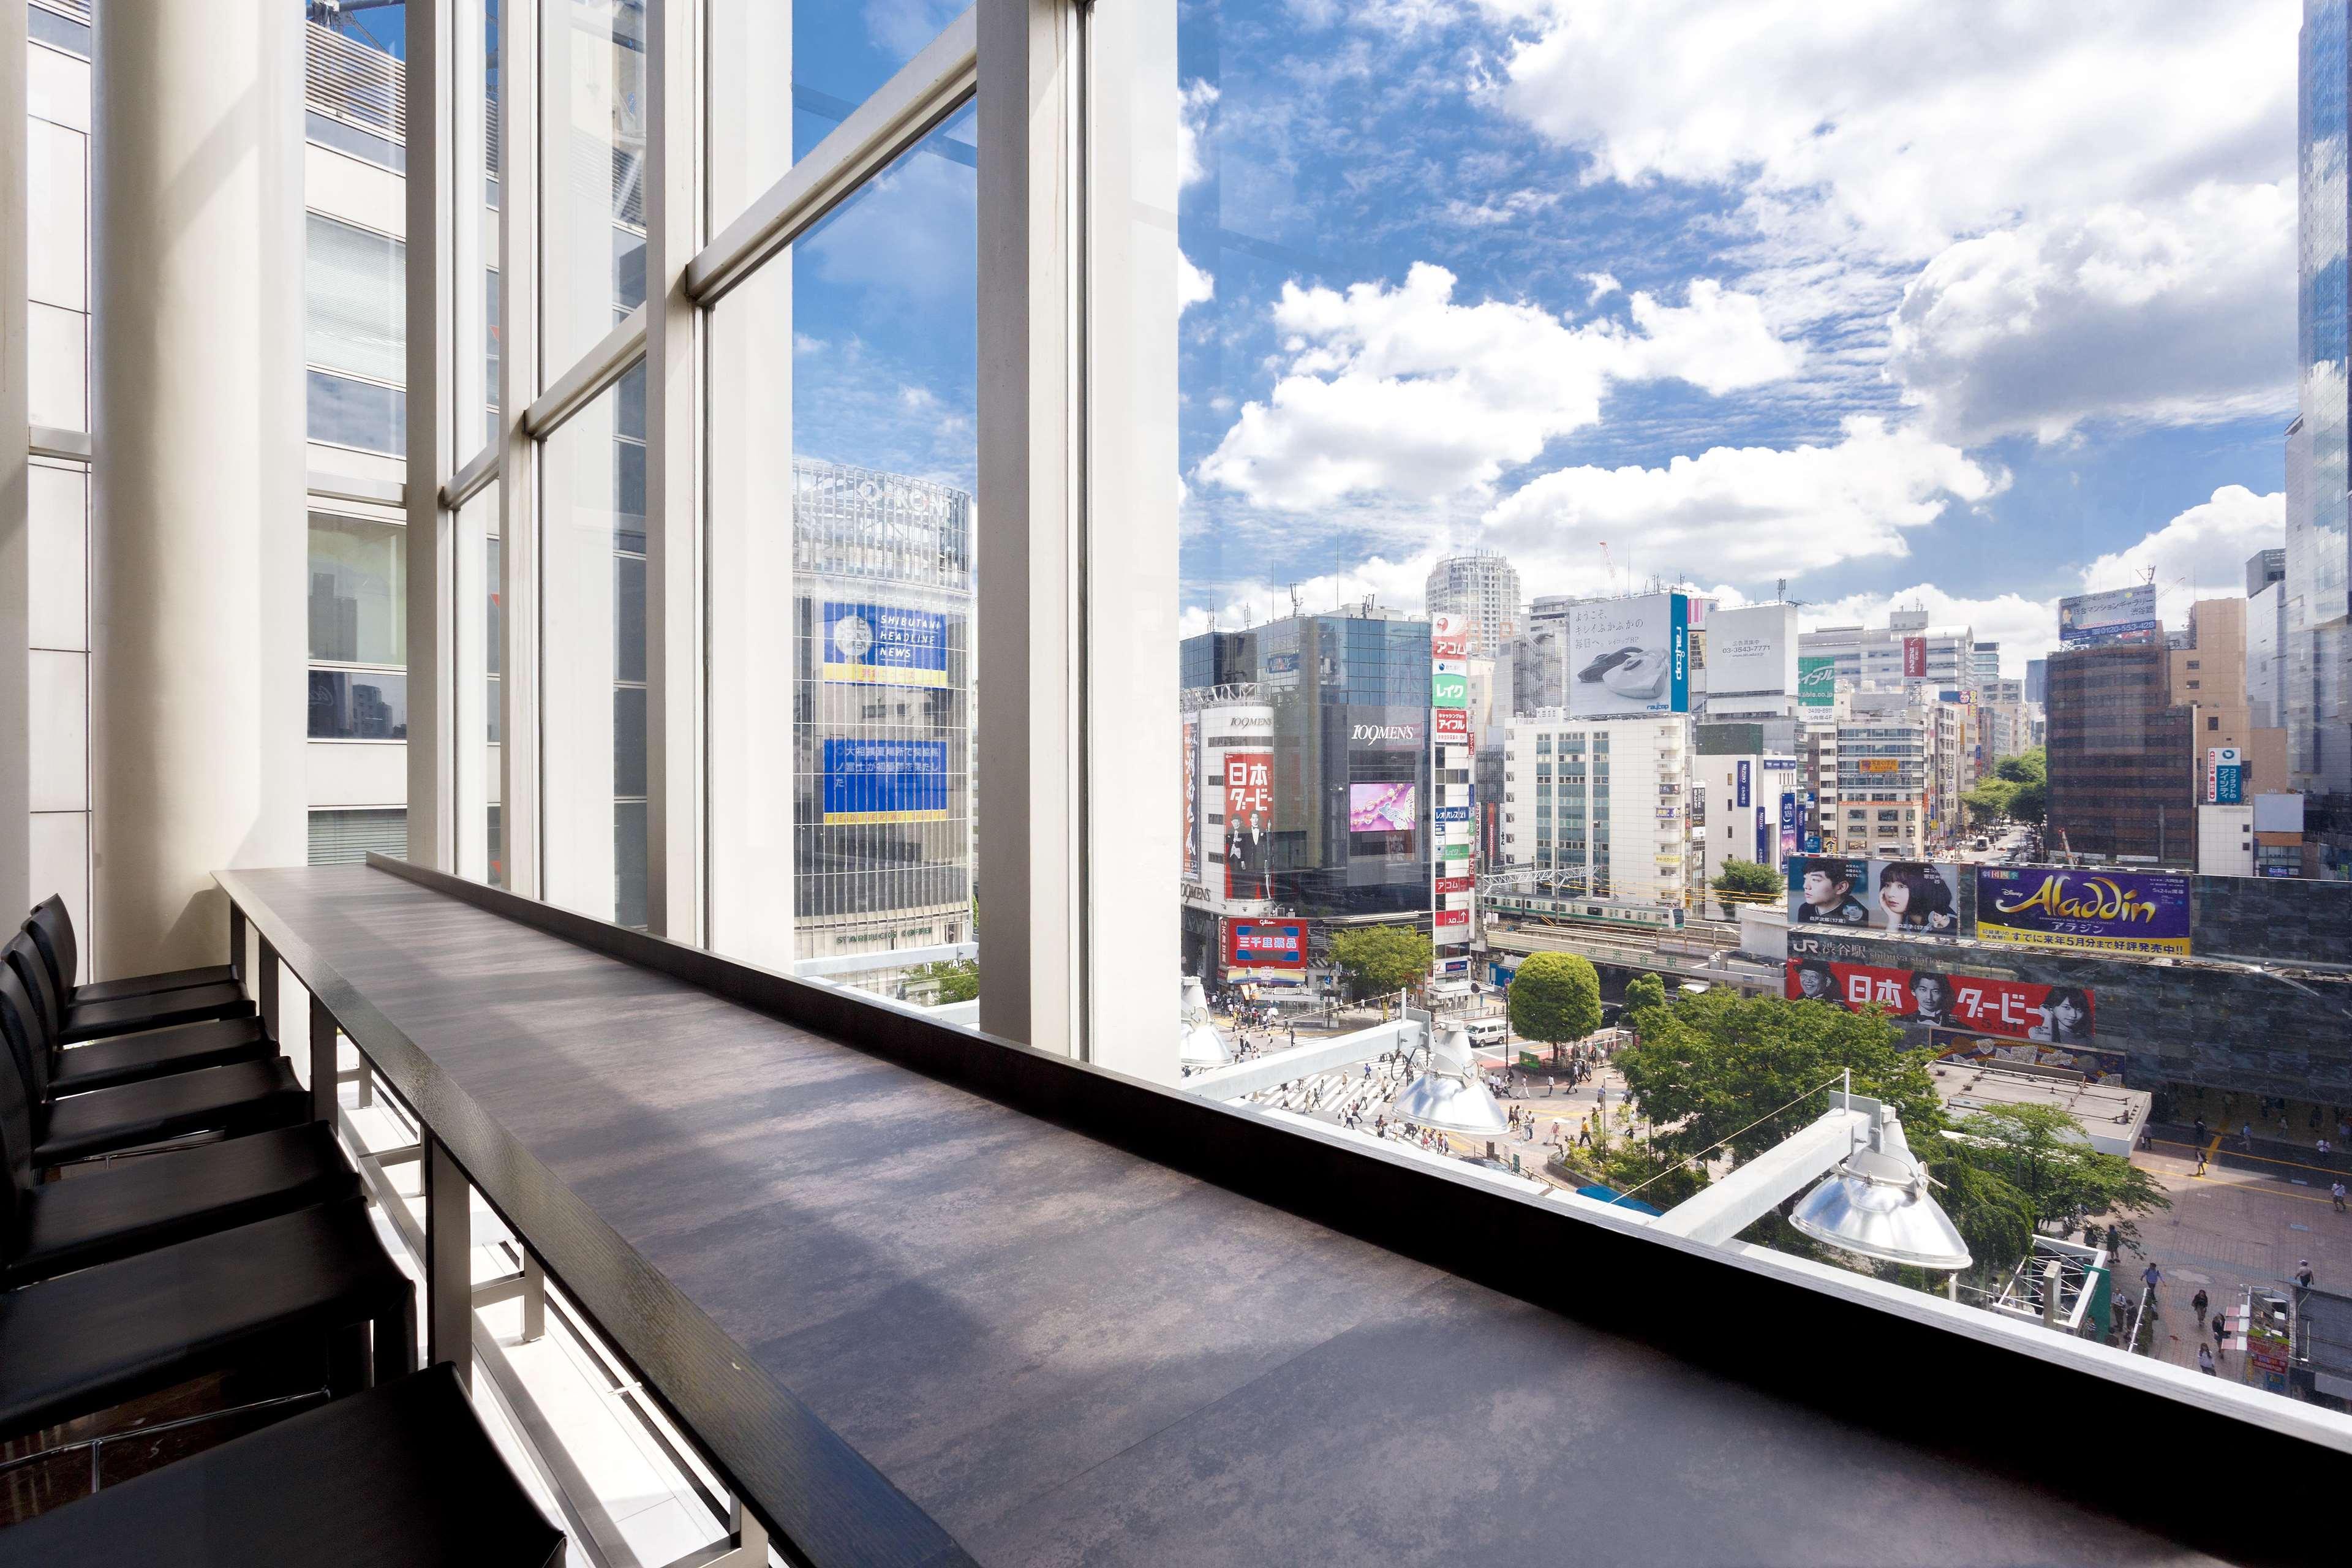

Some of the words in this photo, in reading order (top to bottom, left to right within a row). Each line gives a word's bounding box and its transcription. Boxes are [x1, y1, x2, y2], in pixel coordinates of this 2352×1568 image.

[2101, 622, 2154, 635] 0120-553-428
[880, 631, 935, 644] HEADLINE
[880, 648, 911, 658] NEWS
[1436, 641, 1466, 655] アコム
[1675, 626, 1685, 680] raycop
[1722, 645, 1771, 654] 03-3543-7771
[1436, 684, 1464, 698] レイク
[1646, 702, 1669, 710] raycop
[1438, 719, 1465, 730] アイフル
[1351, 725, 1414, 746] 109MEN'S
[1229, 763, 1268, 786] 日本
[1230, 788, 1273, 811] ダービー
[1438, 881, 1458, 890] アコム
[1996, 875, 2156, 924] Aladdin
[2052, 921, 2104, 934] アラジン
[1238, 937, 1297, 949] 三千里薬品
[2011, 931, 2184, 956] すでに来年5月分まで好評発売中!!
[1793, 939, 1819, 954] JR
[1822, 941, 1866, 958] 渋谷駅
[1870, 951, 1907, 962] shibuya
[1613, 949, 1677, 967] 渋谷駅
[1849, 974, 1902, 1008] 日本
[1958, 987, 2042, 1024] ダービー
